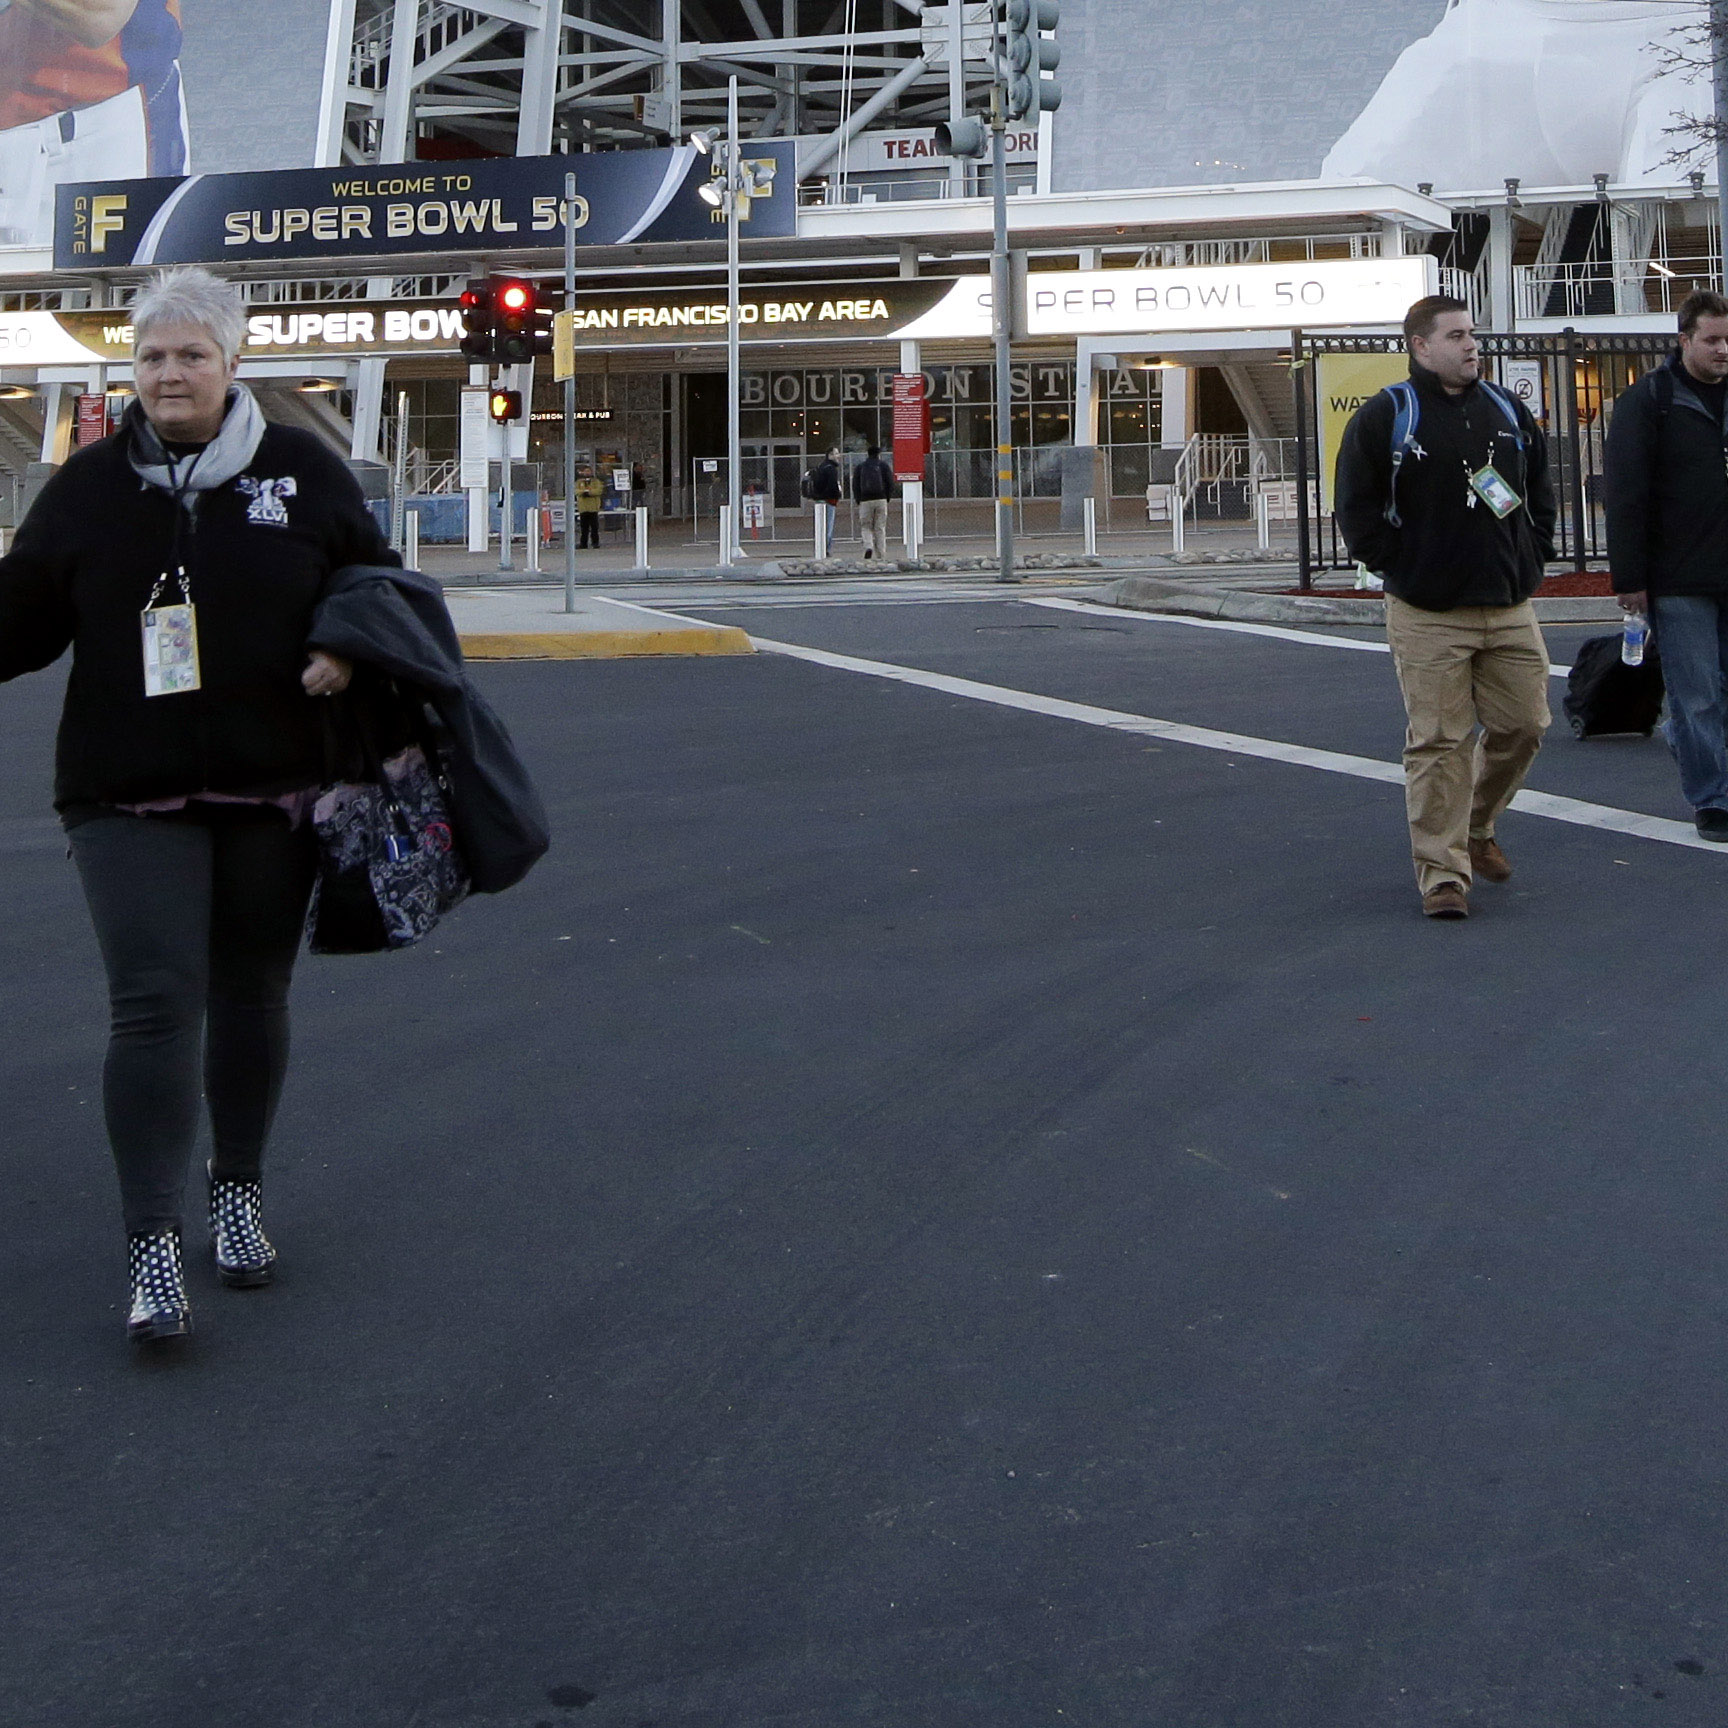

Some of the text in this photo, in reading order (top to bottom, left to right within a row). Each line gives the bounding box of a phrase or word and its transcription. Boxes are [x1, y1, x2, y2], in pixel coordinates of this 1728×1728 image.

[331, 175, 472, 198] WELCOME TO
[72, 196, 87, 255] GATE
[90, 194, 128, 254] F
[224, 193, 590, 246] SUPER BOWL 50
[573, 298, 890, 330] SAN FRANCISO BAY AREA
[976, 280, 1325, 316] SPER BOWL 50
[247, 308, 468, 346] SUPER BOW
[246, 508, 288, 524] XLVI
